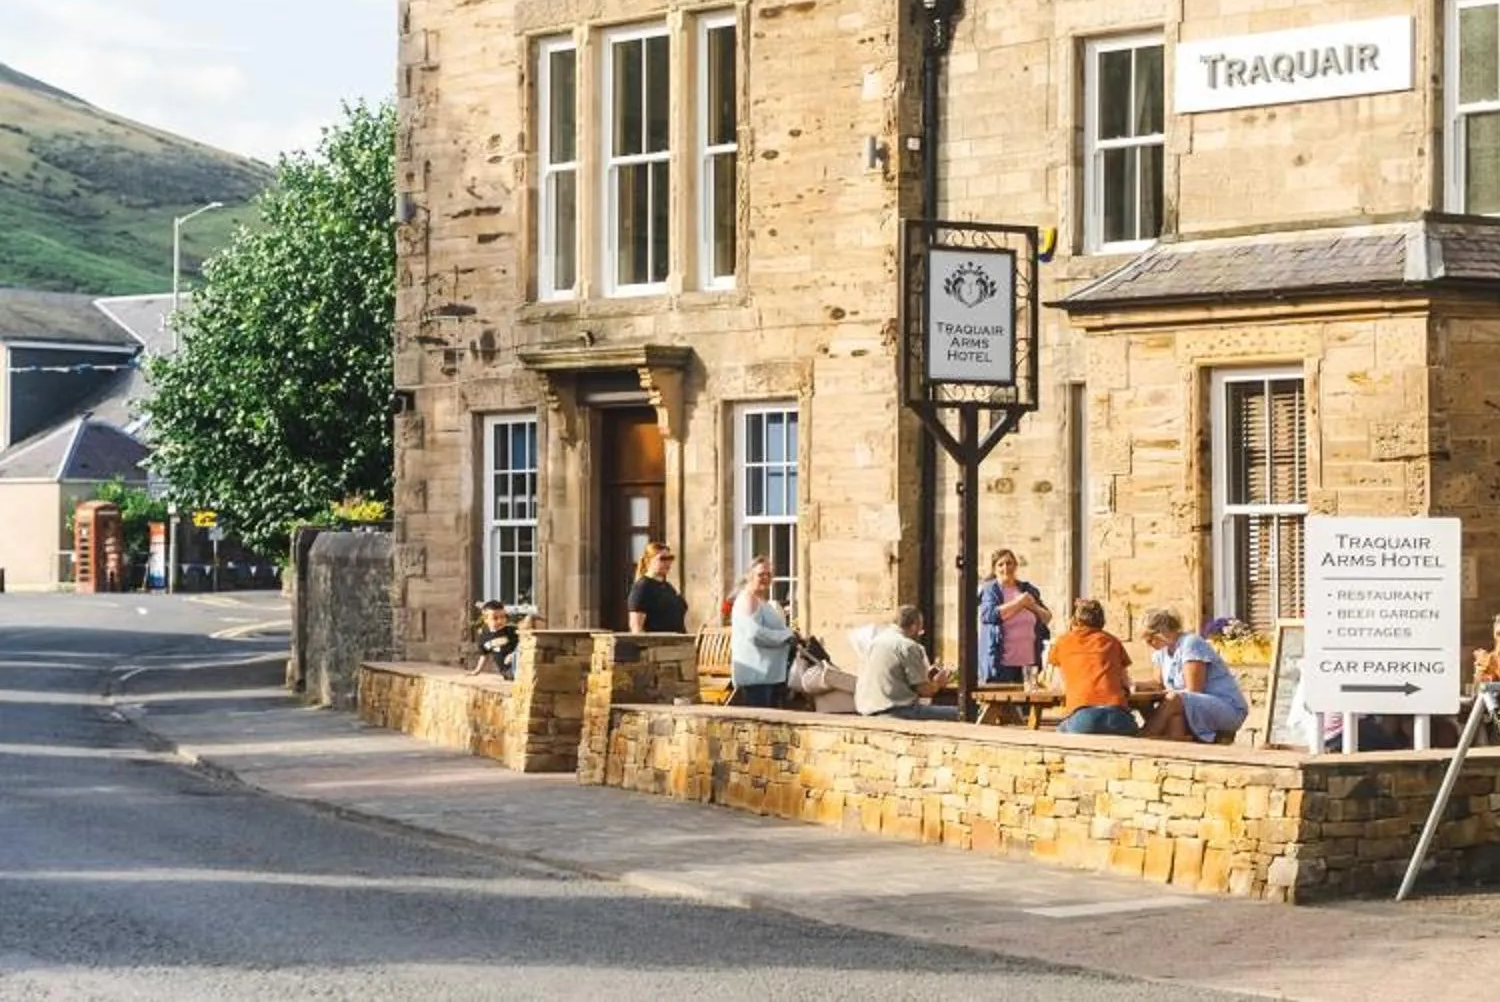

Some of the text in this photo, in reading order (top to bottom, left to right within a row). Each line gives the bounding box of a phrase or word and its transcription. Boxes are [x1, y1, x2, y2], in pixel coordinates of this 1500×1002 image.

[1337, 590, 1432, 602] RESTAURANT
[1337, 608, 1440, 619] BEER GARDEN
[1337, 627, 1412, 638] COTTAGES
[1319, 660, 1446, 674] CAR PARKING
